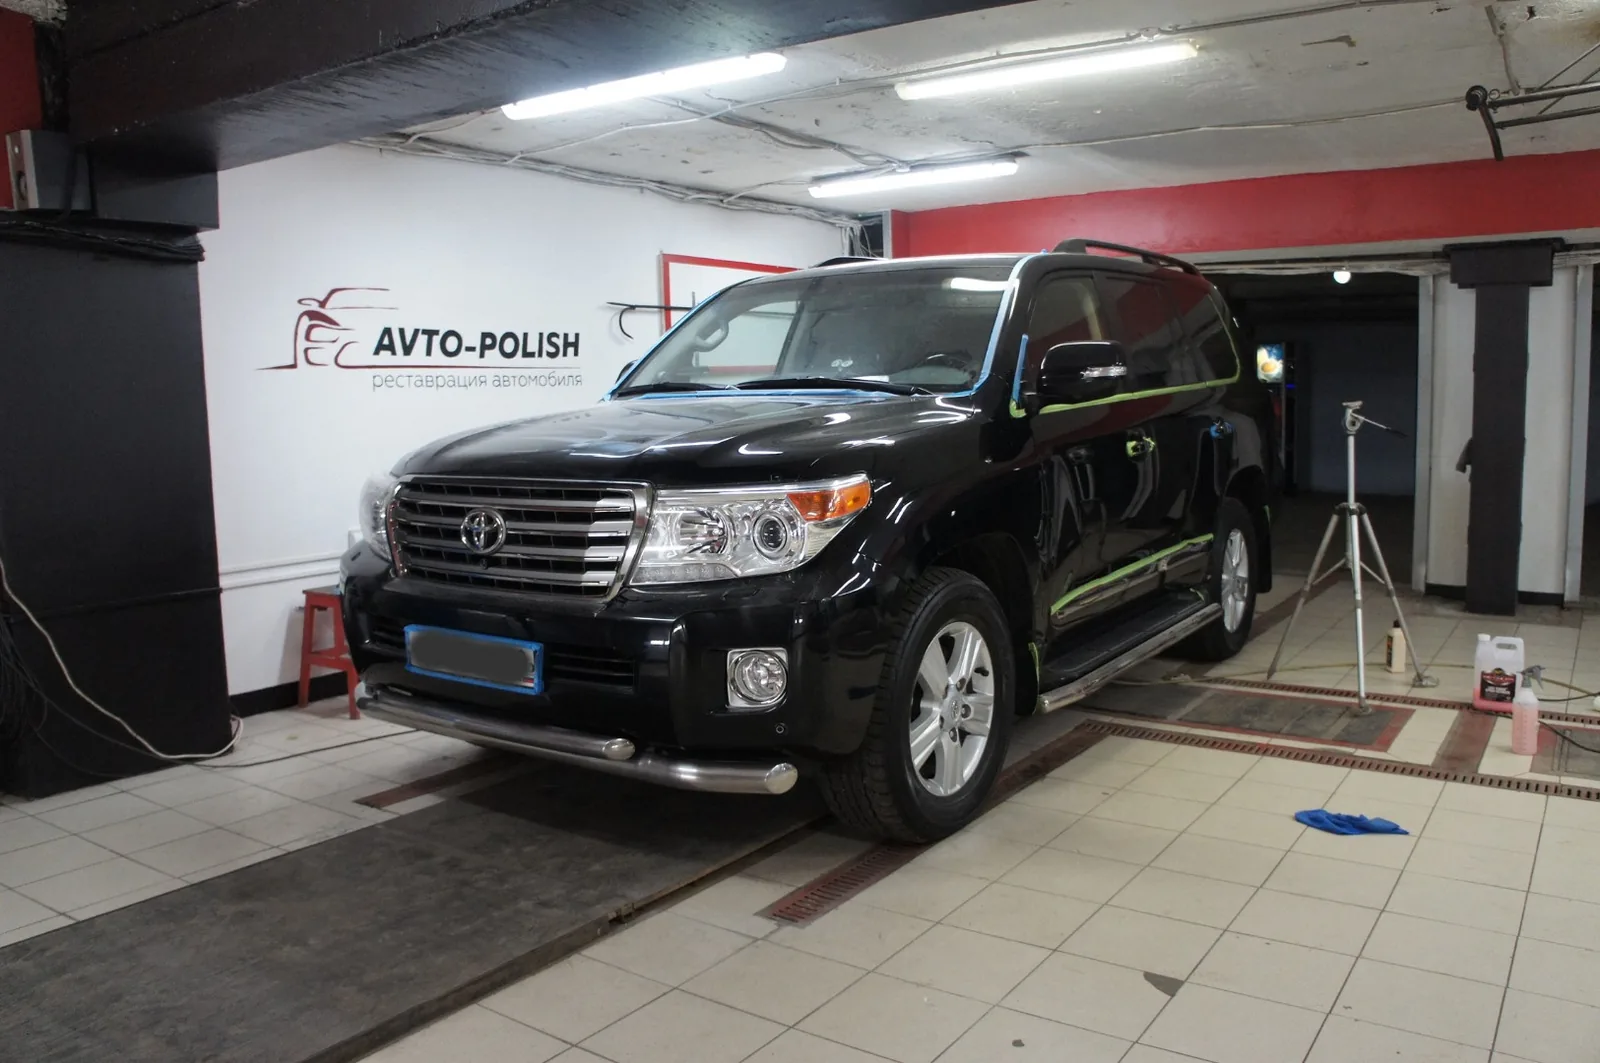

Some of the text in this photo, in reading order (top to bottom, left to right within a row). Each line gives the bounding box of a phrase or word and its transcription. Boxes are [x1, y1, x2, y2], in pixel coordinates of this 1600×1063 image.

[372, 327, 580, 359] AVTO-POLISH
[372, 370, 583, 391] реставрация автомобиля
